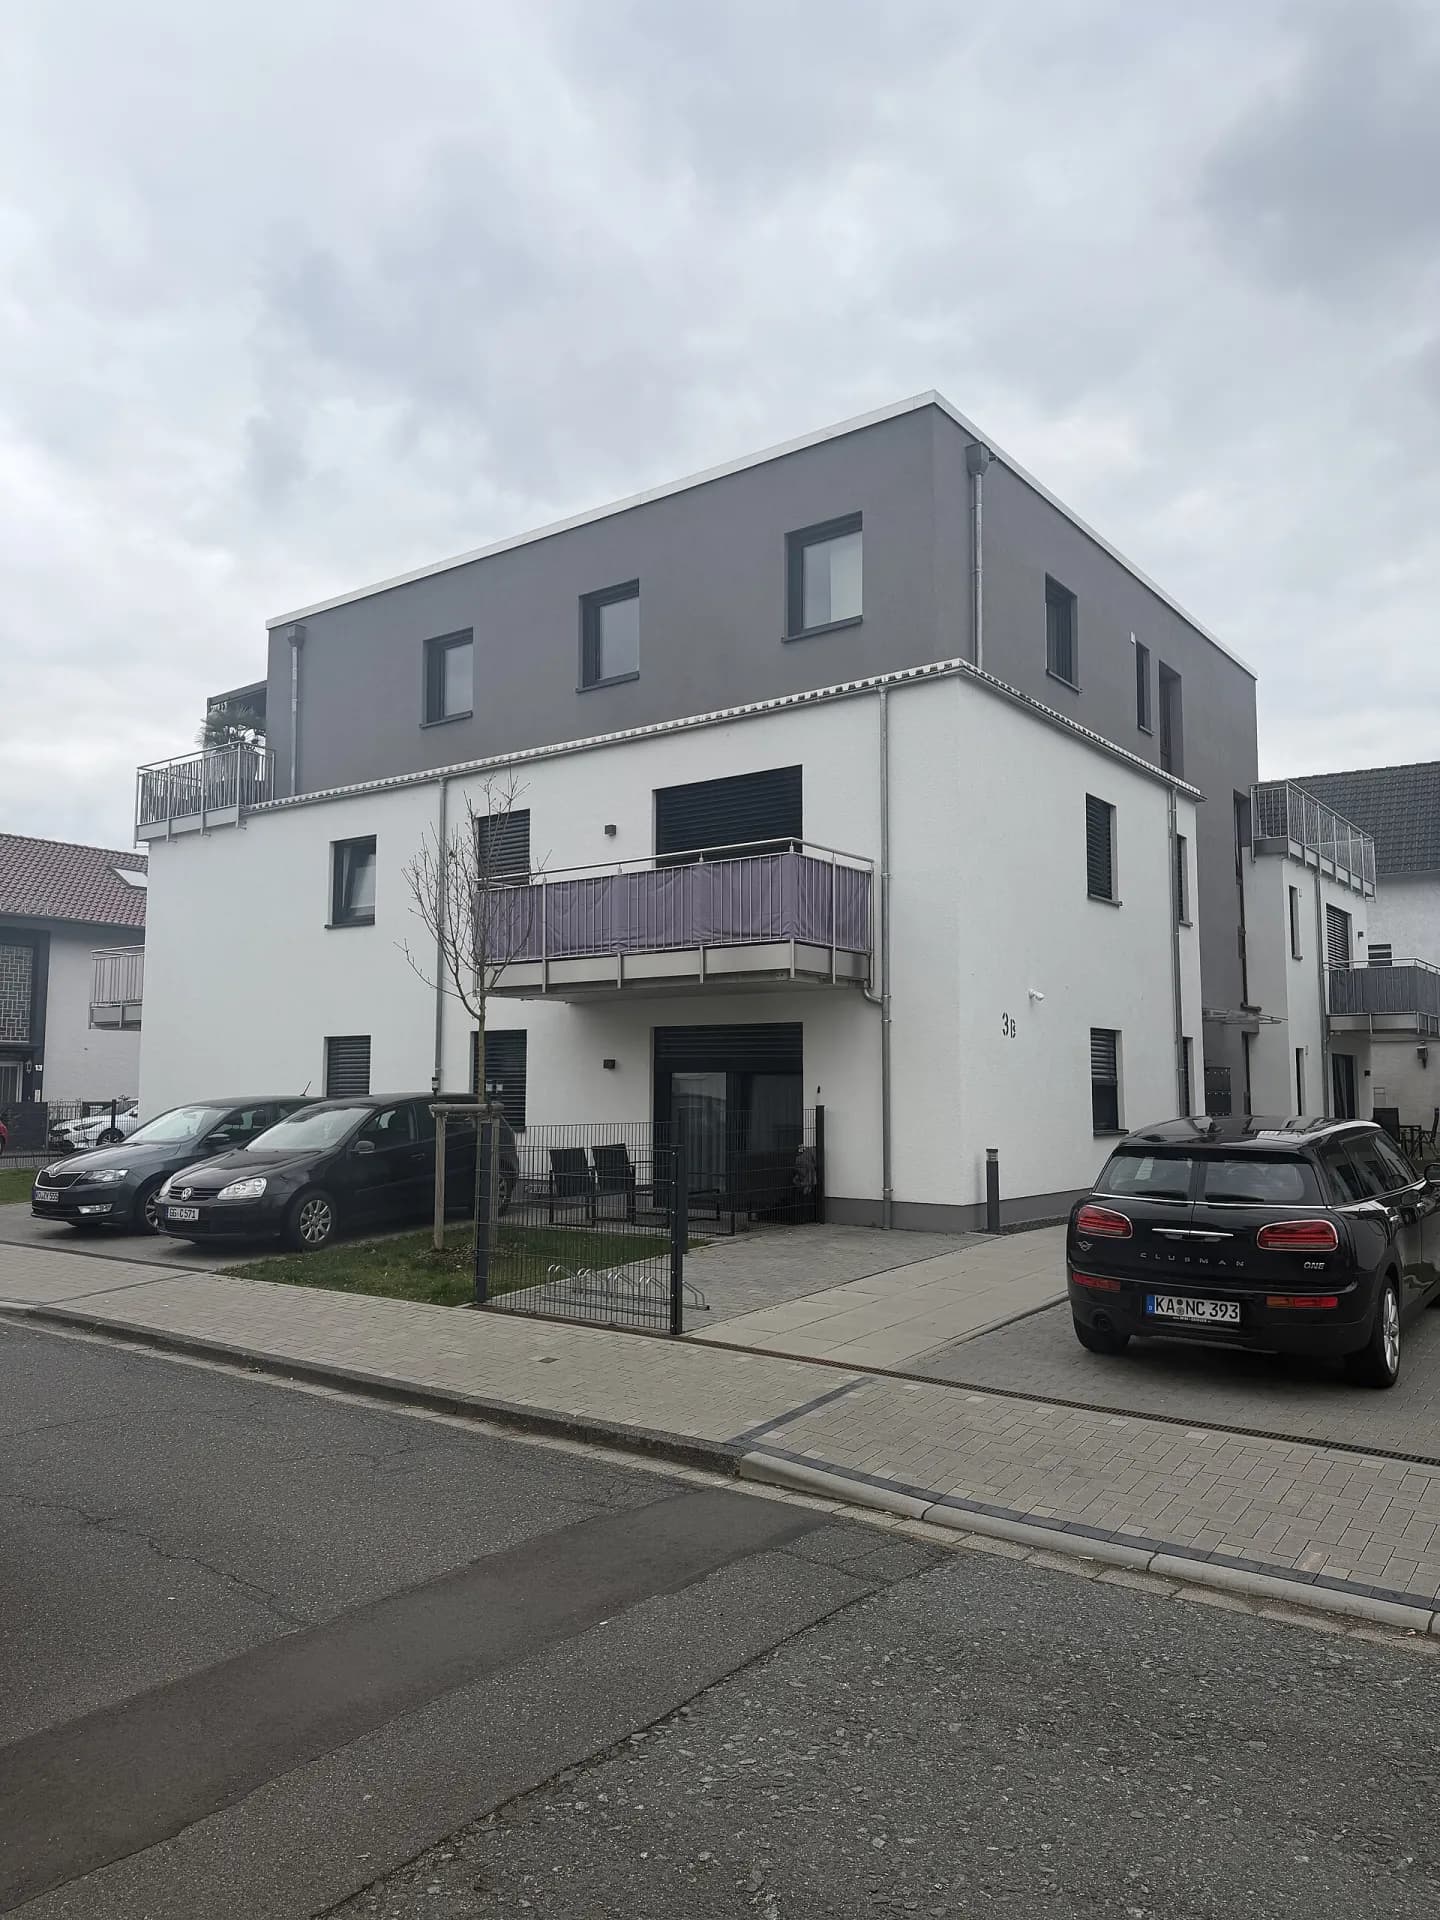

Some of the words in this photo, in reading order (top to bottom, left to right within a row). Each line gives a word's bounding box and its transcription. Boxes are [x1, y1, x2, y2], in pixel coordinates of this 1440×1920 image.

[1002, 1011, 1016, 1039] 3B
[1139, 1252, 1245, 1267] CLUBMAN
[1303, 1261, 1325, 1271] ONE
[1156, 1297, 1175, 1314] KA
[1185, 1300, 1205, 1316] NC
[1209, 1302, 1238, 1319] 393
